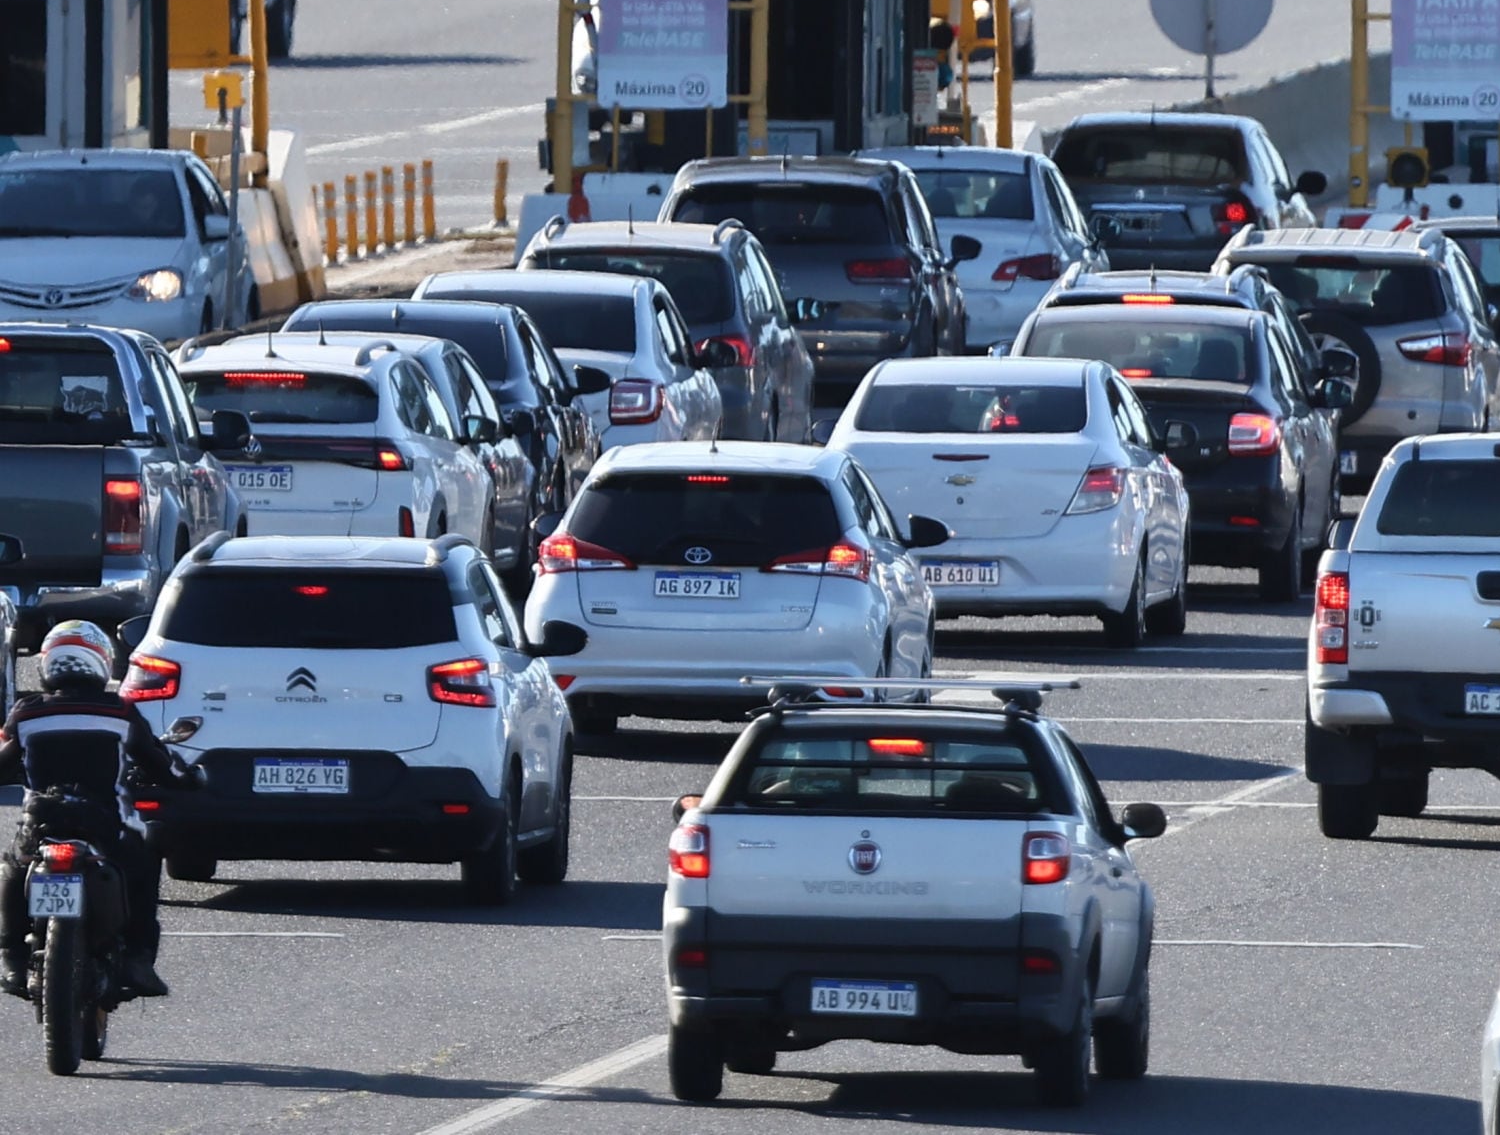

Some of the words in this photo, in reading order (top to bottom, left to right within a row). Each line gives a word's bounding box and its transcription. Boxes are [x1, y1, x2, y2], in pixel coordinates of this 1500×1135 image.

[622, 31, 705, 48] TelePASE
[1414, 43, 1496, 60] TelePASE
[615, 81, 676, 96] Máxima
[685, 81, 706, 96] 20
[1407, 92, 1470, 107] Máxima
[1478, 92, 1499, 107] 20
[238, 472, 266, 488] 015
[924, 567, 942, 583] AB
[947, 568, 974, 583] 610
[978, 568, 995, 583] UI
[658, 579, 678, 594] AG
[683, 580, 712, 595] 897
[718, 581, 737, 596] IK
[1469, 693, 1489, 711] AC
[257, 769, 280, 785] AH
[284, 769, 317, 785] 826
[323, 769, 344, 785] YG
[41, 883, 70, 898] A26
[801, 880, 930, 896] WORKING
[35, 898, 76, 913] 7JPY
[816, 989, 839, 1009] AB
[846, 990, 881, 1010] 994
